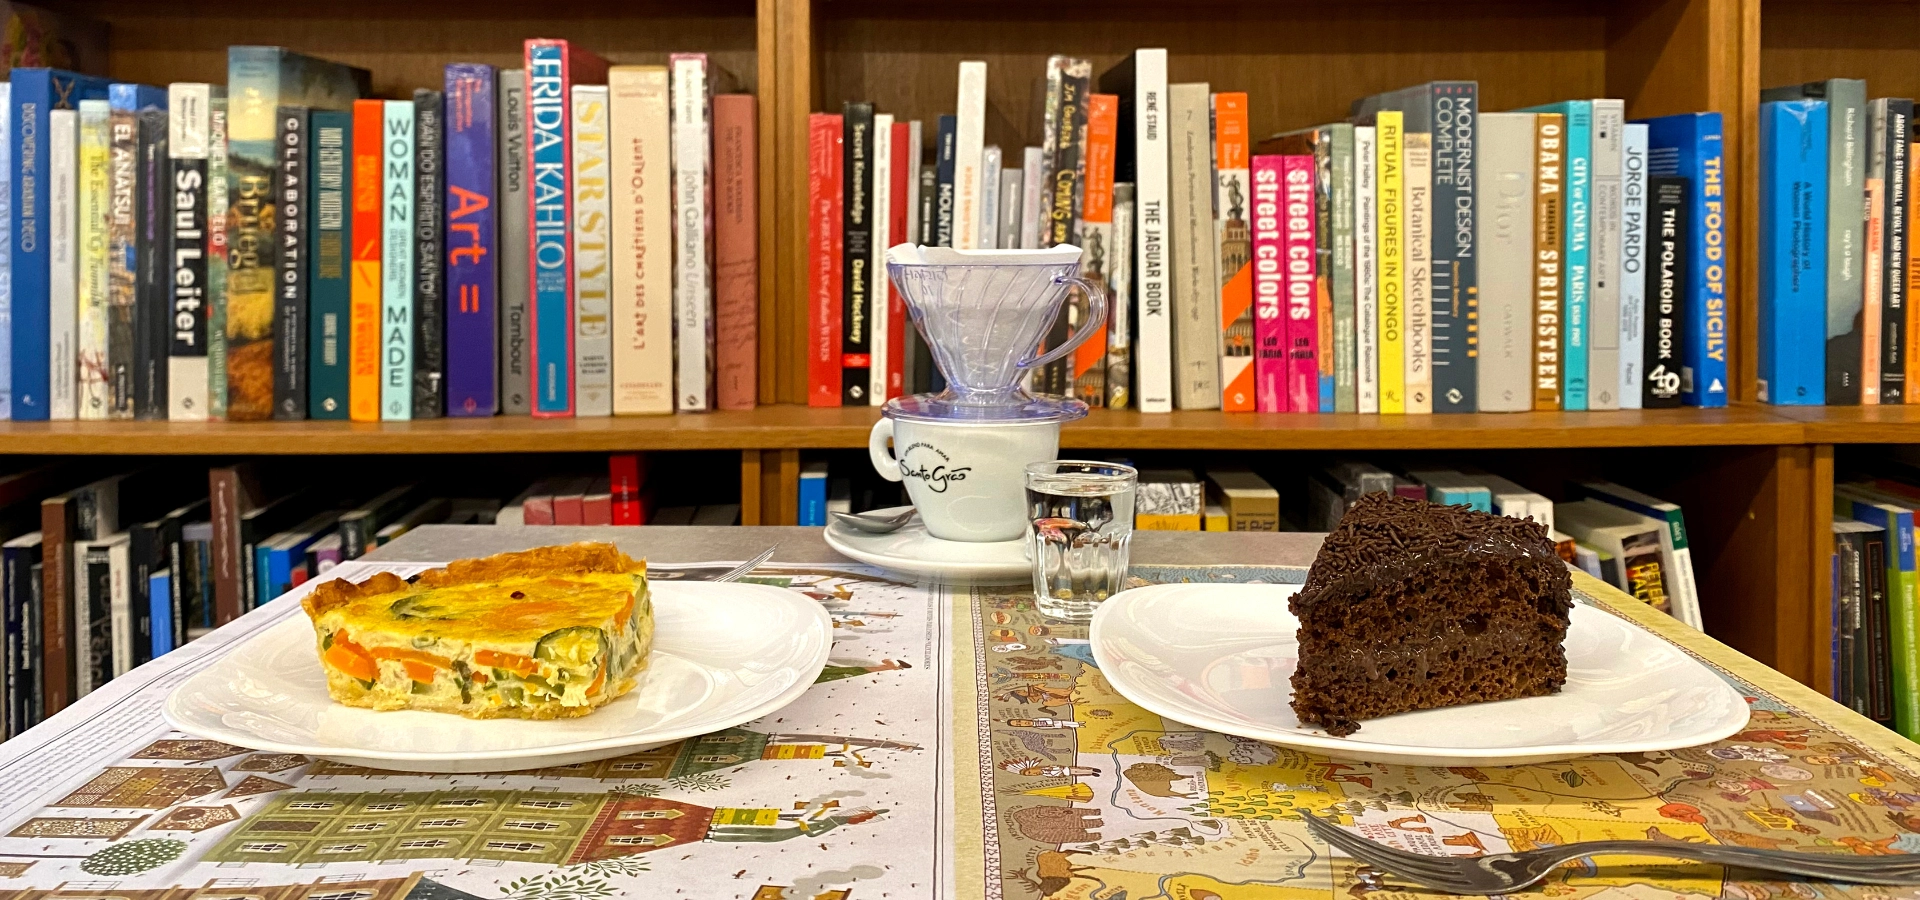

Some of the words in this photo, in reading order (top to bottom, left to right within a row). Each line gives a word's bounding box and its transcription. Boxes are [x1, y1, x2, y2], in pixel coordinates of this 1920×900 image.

[506, 88, 521, 134] Louis
[531, 58, 564, 150] FRIDA
[1146, 91, 1159, 114] RENÉ
[22, 103, 37, 174] DISCOVERING
[114, 123, 132, 143] EL
[852, 123, 867, 160] Secret
[1146, 115, 1158, 141] STAUD
[1436, 97, 1454, 185] COMPLETE
[1845, 107, 1855, 140] Richard
[1895, 113, 1906, 139] ABOUT
[506, 135, 521, 193] Vuitton
[1362, 140, 1371, 161] Peter
[1384, 125, 1397, 183] RITUAL
[1455, 97, 1474, 193] MODERNIST
[1540, 123, 1560, 195] OBAMA
[1842, 141, 1855, 187] Billingham
[1894, 139, 1905, 160] FACE:
[114, 146, 132, 226] ANATSUI
[388, 118, 411, 224] WOMAN
[682, 169, 700, 205] John
[1361, 163, 1371, 189] Halley
[1572, 157, 1587, 187] CITY
[1625, 145, 1643, 207] JORGE
[1704, 156, 1721, 196] THE
[1893, 160, 1905, 206] STONEWALL,
[176, 169, 203, 240] Saul
[284, 116, 300, 299] COLLABORATION
[849, 160, 867, 225] Knowledge
[1256, 168, 1280, 242] street
[1288, 168, 1312, 242] street
[1792, 181, 1802, 218] Women
[1803, 191, 1812, 220] World
[448, 185, 489, 267] Art
[535, 161, 566, 271] KAHLO
[937, 183, 953, 248] MOUNTAI
[1144, 200, 1161, 226] THE
[1361, 196, 1372, 234] Paintings
[1384, 188, 1398, 257] FIGURES
[1411, 186, 1428, 261] Botanical
[1455, 194, 1473, 258] DESIGN
[1571, 200, 1587, 252] CINEMA
[1598, 184, 1609, 262] CONTEMPORARY
[1662, 208, 1676, 237] THE
[1705, 202, 1722, 260] FOOD
[1892, 206, 1904, 236] REVOLT,
[22, 219, 37, 252] DECO
[684, 206, 700, 271] Galliano
[1144, 228, 1161, 278] JAGUAR
[1624, 211, 1642, 274] PARDO
[1801, 222, 1812, 255] History
[1870, 217, 1880, 252] MARINA
[1892, 236, 1903, 251] AND
[576, 210, 607, 337] STYLE
[852, 258, 866, 293] David
[1385, 260, 1398, 277] IN
[1598, 262, 1608, 280] ART
[1789, 220, 1802, 293] Photographers
[1803, 260, 1812, 270] of
[1891, 252, 1903, 268] NEW
[176, 247, 203, 347] Leiter
[1256, 244, 1283, 321] colors
[1289, 244, 1315, 321] colors
[1363, 286, 1372, 302] The
[1571, 265, 1587, 303] PARIS
[1660, 241, 1675, 314] POLAROID
[1706, 264, 1722, 294] OF
[1890, 268, 1902, 293] QUEER
[685, 272, 700, 329] Unseen
[848, 293, 866, 345] Hockney
[1145, 281, 1162, 317] BOOK
[1385, 281, 1399, 341] CONGO
[1537, 249, 1559, 389] SPRINGSTEEN
[1890, 293, 1901, 309] ART
[508, 302, 524, 375] Tambour
[1362, 303, 1373, 343] Catalogue
[1411, 267, 1428, 373] Sketchbooks
[1658, 318, 1673, 360] BOOK
[1707, 297, 1725, 361] SICILY
[388, 305, 408, 388] MADE
[1263, 336, 1278, 348] LEO
[1294, 337, 1310, 348] LEO
[1648, 364, 1681, 391] 40
[921, 442, 934, 451] PARA
[935, 448, 950, 463] AMAR
[899, 458, 931, 482] Santo
[928, 465, 972, 494] Grão
[1646, 561, 1665, 606] PETER
[1905, 584, 1915, 609] Projeto
[1906, 609, 1916, 642] Integrado
[1907, 648, 1918, 691] Construções
[1910, 691, 1920, 735] Sustentáveis
[1125, 787, 1167, 816] Montana
[1236, 819, 1258, 839] PARQUE
[1253, 827, 1280, 852] NACIONAL
[1258, 819, 1293, 853] YELLOWSTONE
[1356, 821, 1370, 837] SALT
[1368, 823, 1386, 839] LAKE
[1379, 823, 1397, 838] CITY
[1235, 847, 1261, 868] Idaho
